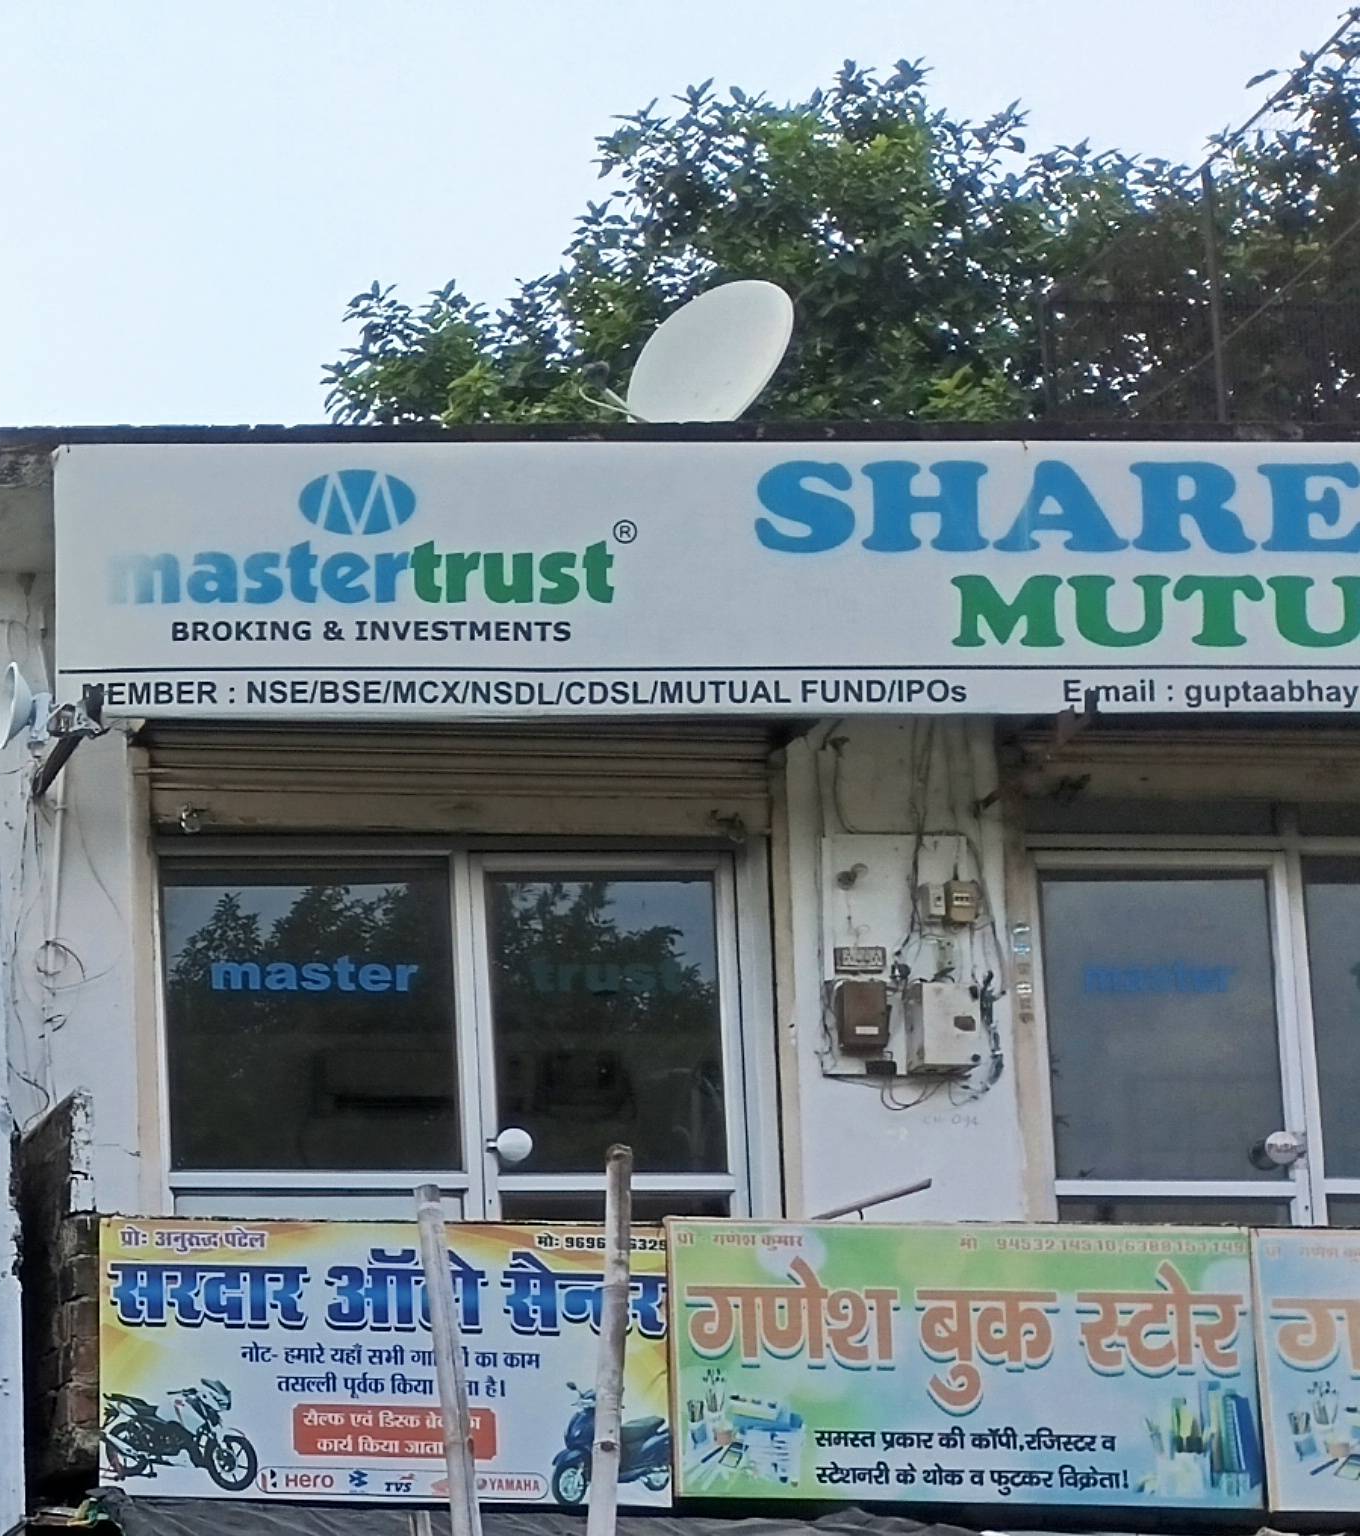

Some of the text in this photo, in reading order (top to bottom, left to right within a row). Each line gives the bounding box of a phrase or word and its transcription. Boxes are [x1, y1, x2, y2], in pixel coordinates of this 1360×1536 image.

[754, 460, 1360, 553] SHARE
[107, 540, 615, 604] mastertrust
[951, 575, 1360, 648] MUTU
[171, 620, 572, 643] BROKING & INVESTMENTS
[246, 679, 791, 706] NSE/BSE/MCX/NSDL/CDSL/MUTUAL
[801, 679, 967, 705] FUND/IPOs
[1184, 679, 1360, 709] guptaabhay
[210, 955, 418, 992] master
[224, 1227, 265, 1248] पटेल
[108, 1261, 310, 1329] सरदार
[684, 1256, 899, 1370] गणेश
[916, 1287, 1059, 1415] बुक
[1077, 1259, 1248, 1375] स्टोर
[284, 1342, 325, 1365] हमारे
[367, 1344, 404, 1367] सभी
[475, 1350, 498, 1368] का
[503, 1350, 540, 1370] काम
[277, 1372, 337, 1394] तसल्ली
[343, 1372, 385, 1399] पूर्वक
[390, 1373, 433, 1395] किया
[358, 1437, 399, 1455] किया
[815, 1430, 876, 1449] समस्त
[881, 1431, 933, 1451] प्रकार
[938, 1426, 967, 1450] की
[1101, 1434, 1116, 1452] व
[488, 1479, 541, 1493] YAMAHA
[816, 1462, 890, 1486] स्टेशनरी
[895, 1463, 917, 1486] के
[922, 1463, 963, 1487] थोक
[970, 1469, 985, 1487] व
[989, 1469, 1052, 1496] फुटकर
